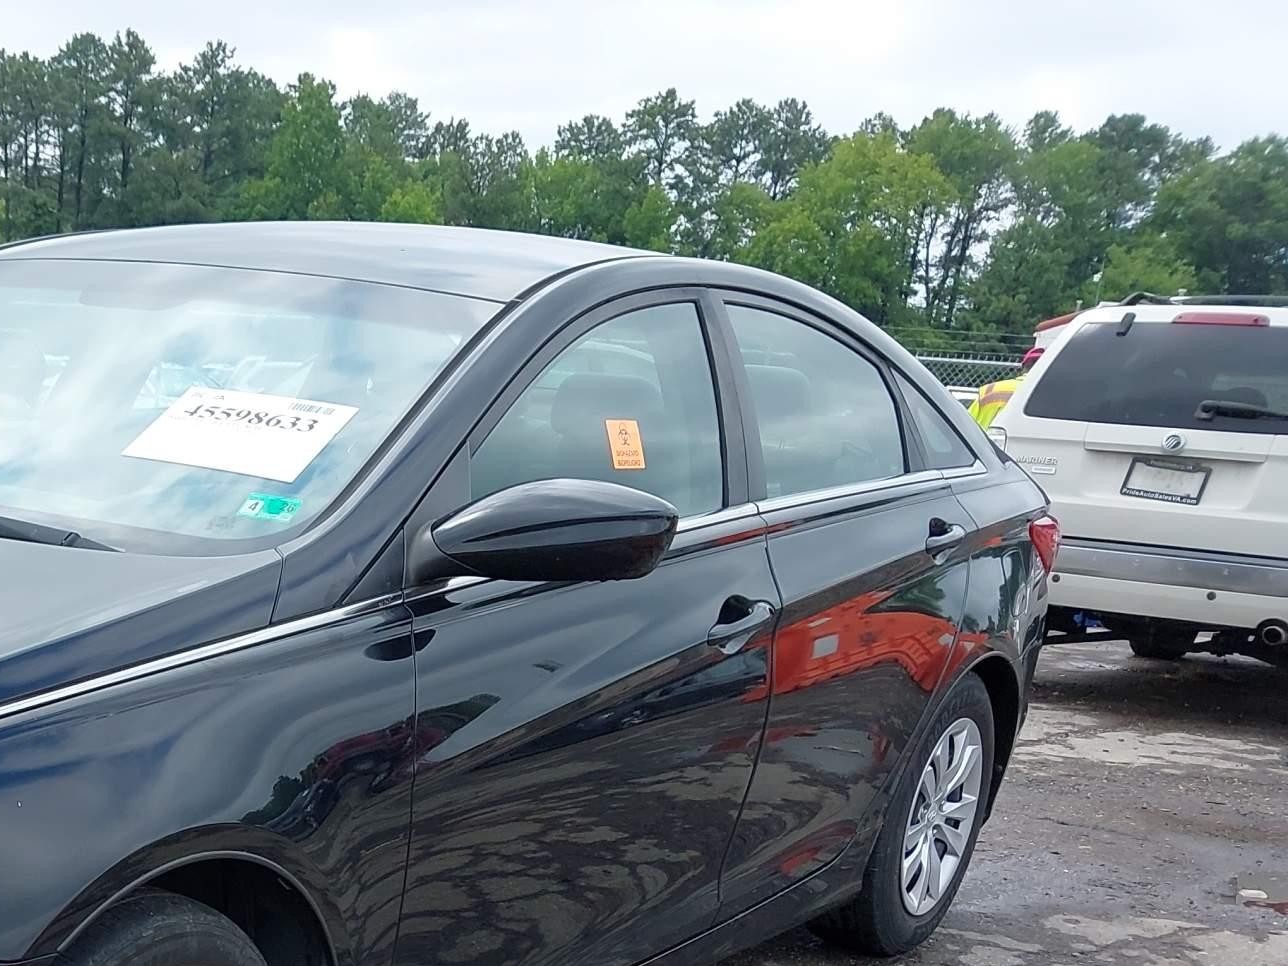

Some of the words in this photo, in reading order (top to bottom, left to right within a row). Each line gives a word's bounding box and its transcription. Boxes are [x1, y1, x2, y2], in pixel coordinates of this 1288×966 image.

[184, 404, 318, 432] 45598633
[1015, 456, 1057, 465] MARINER
[1122, 487, 1197, 504] PrideAutoSalesVA.com
[248, 502, 260, 512] 4
